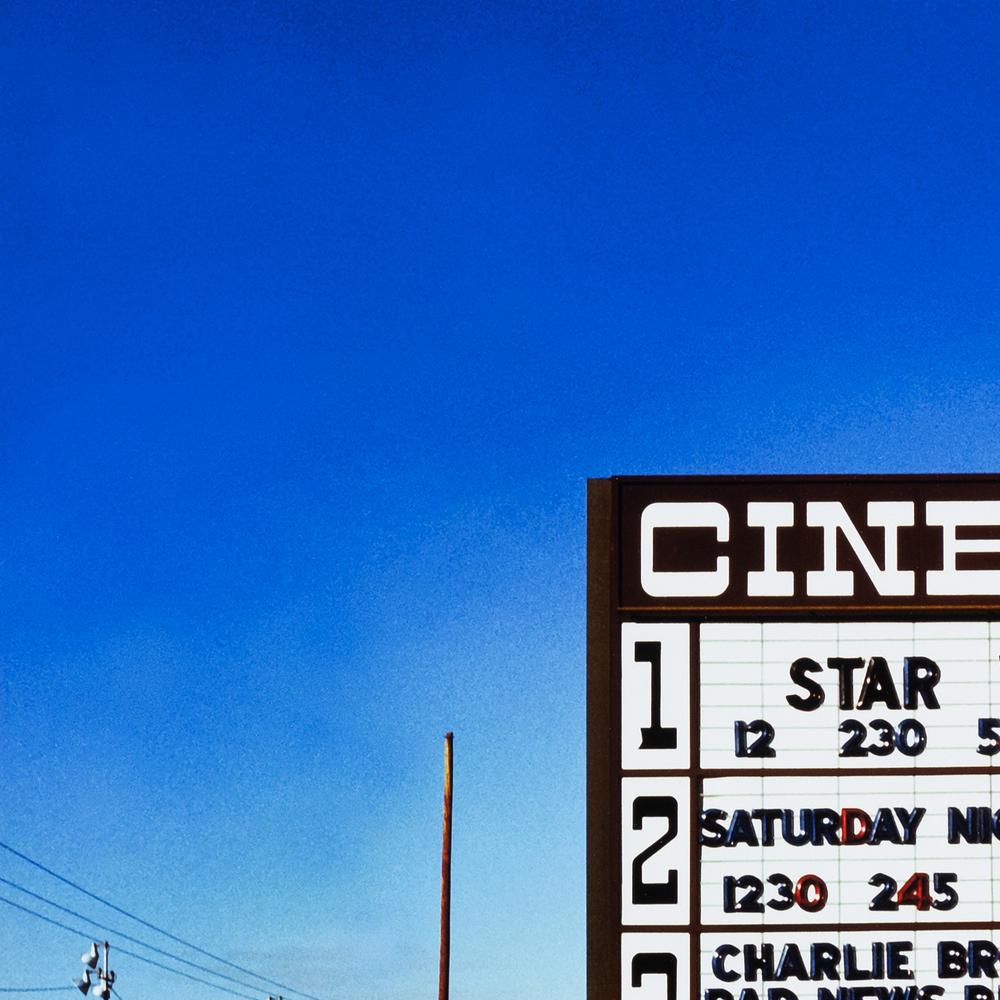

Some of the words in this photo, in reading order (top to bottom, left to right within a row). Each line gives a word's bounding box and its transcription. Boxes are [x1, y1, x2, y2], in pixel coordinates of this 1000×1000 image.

[635, 642, 677, 749] 1
[786, 657, 940, 711] STAR
[735, 720, 776, 758] 12
[838, 719, 927, 757] 230
[700, 804, 926, 847] SATURDAY
[632, 796, 678, 904] 2
[724, 874, 828, 913] 1230
[869, 873, 958, 911] 245
[712, 941, 914, 982] CHARLIE
